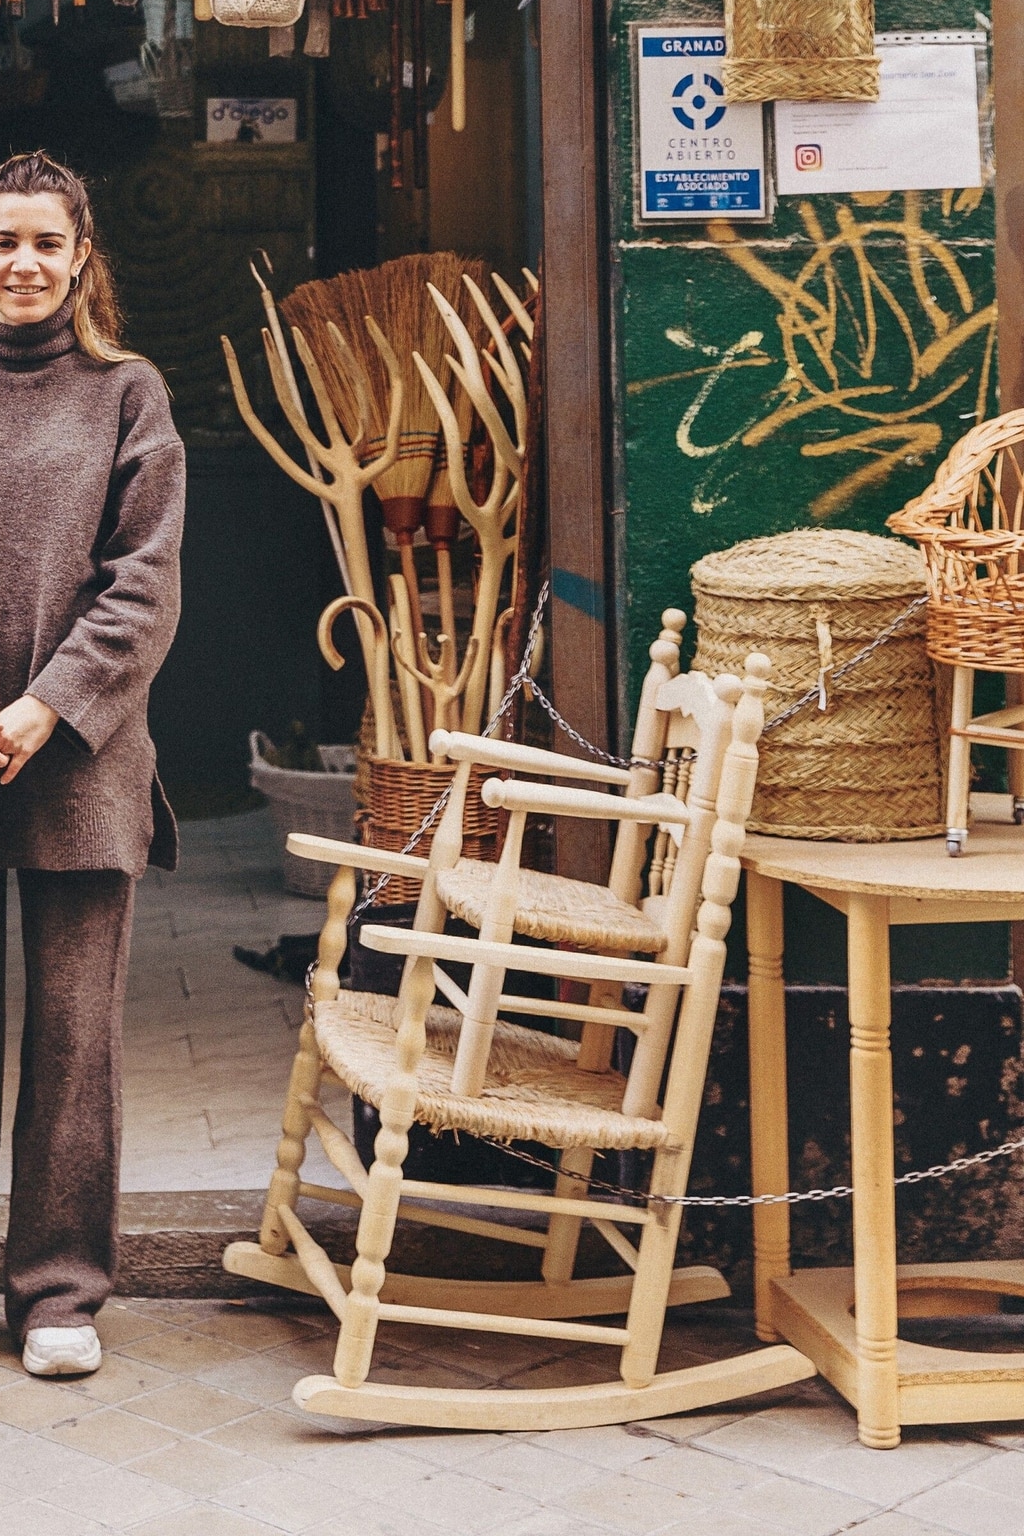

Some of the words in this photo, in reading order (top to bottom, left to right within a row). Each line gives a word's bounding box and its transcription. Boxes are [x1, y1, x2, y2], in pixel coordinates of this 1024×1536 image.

[662, 40, 724, 52] GRANAD
[668, 138, 733, 149] CENTRO
[666, 150, 736, 161] ABIERTO
[655, 172, 750, 183] ESTABLECIMIENTO
[676, 181, 729, 192] ASOCIADO
